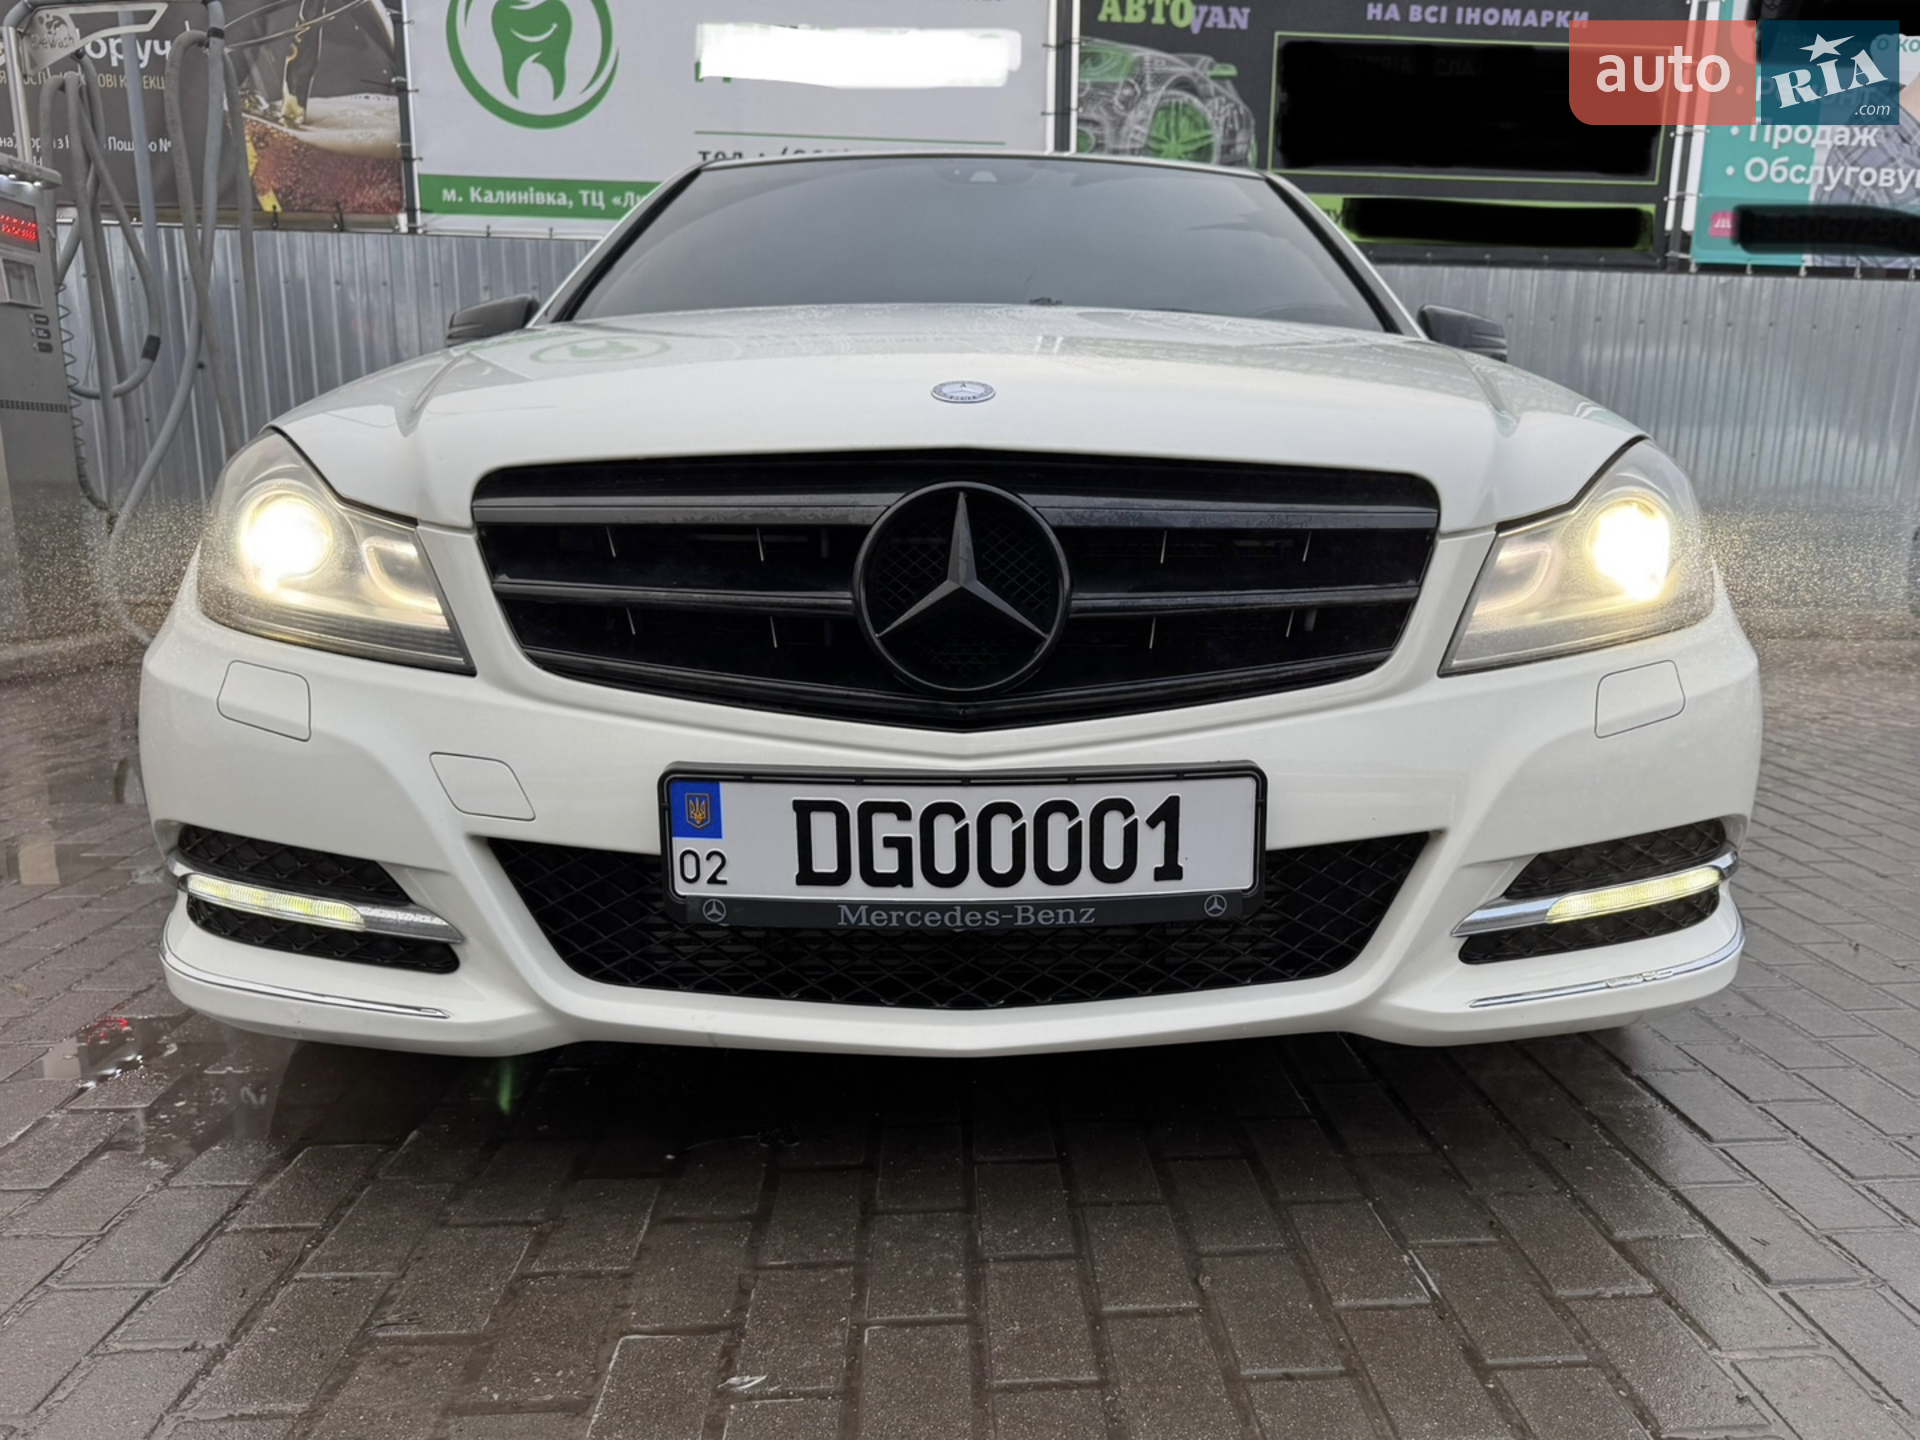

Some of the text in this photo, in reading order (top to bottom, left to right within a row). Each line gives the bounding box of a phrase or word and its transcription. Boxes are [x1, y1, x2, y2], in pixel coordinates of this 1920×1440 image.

[1366, 3, 1589, 28] НА ВСІ ІНОМАРКИ
[1749, 117, 1880, 149] Продаж
[469, 187, 573, 208] Калинівка,
[579, 189, 606, 210] ТЦ
[680, 849, 728, 885] 02
[837, 904, 1096, 927] Mercedes-Benz
